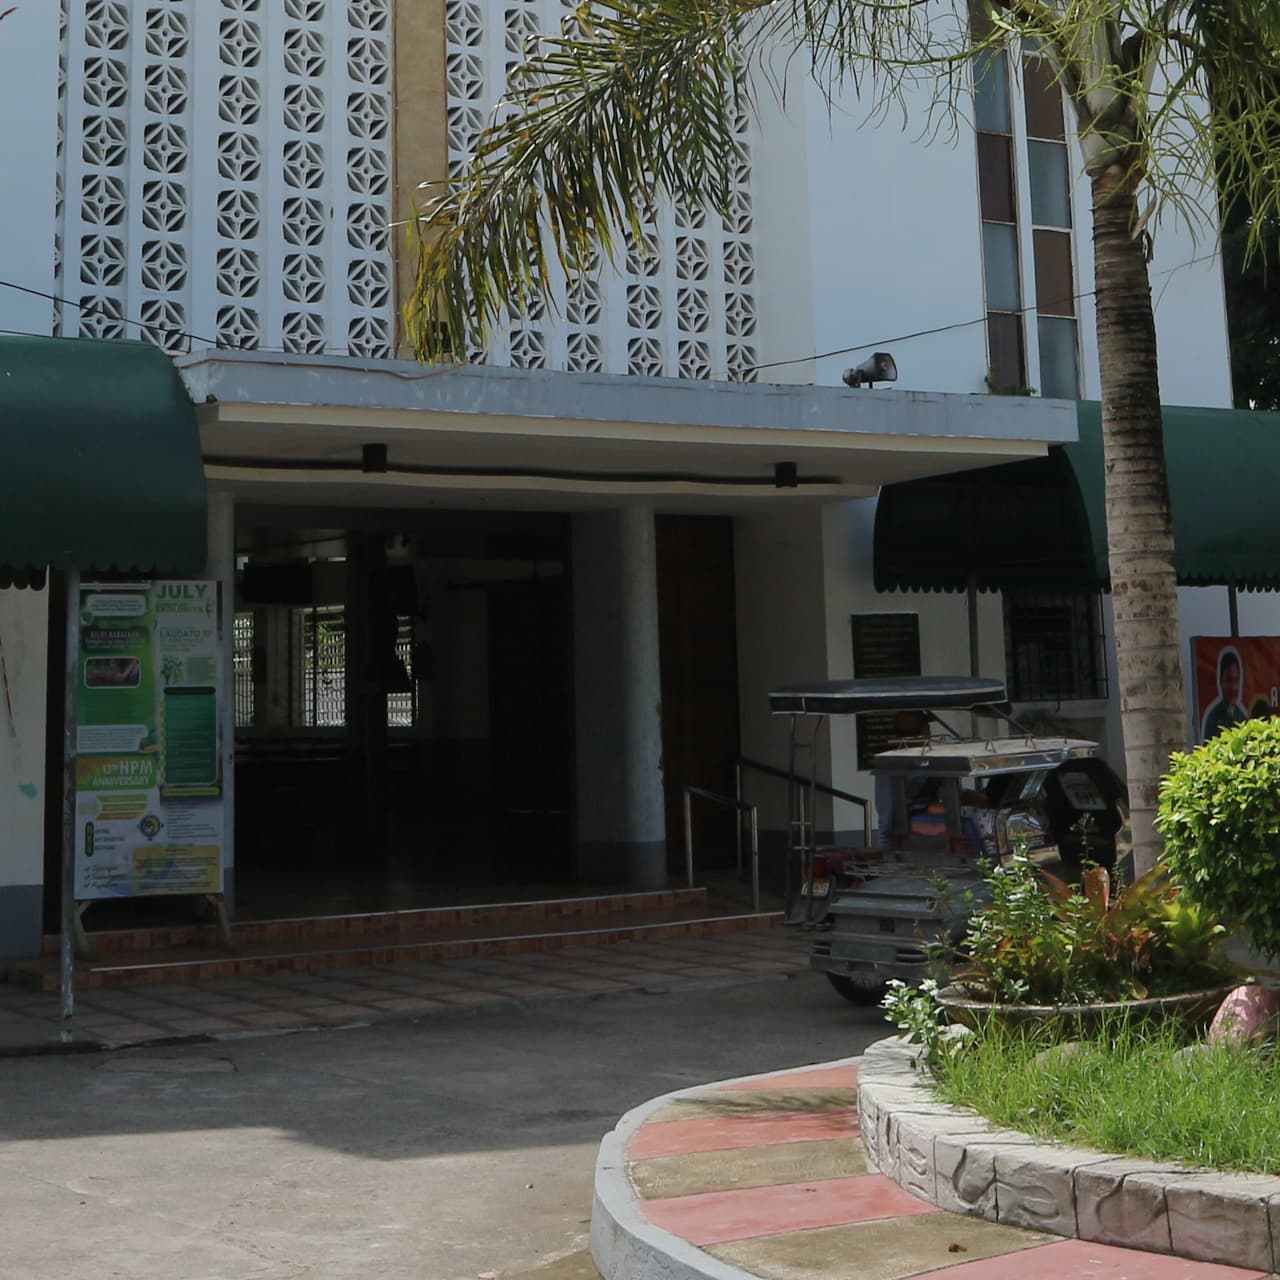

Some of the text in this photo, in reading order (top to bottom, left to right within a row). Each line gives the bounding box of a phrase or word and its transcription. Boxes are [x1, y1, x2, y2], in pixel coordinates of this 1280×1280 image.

[156, 583, 208, 600] JULY
[120, 759, 153, 776] HPM
[93, 775, 150, 787] ANNIVERSARY
